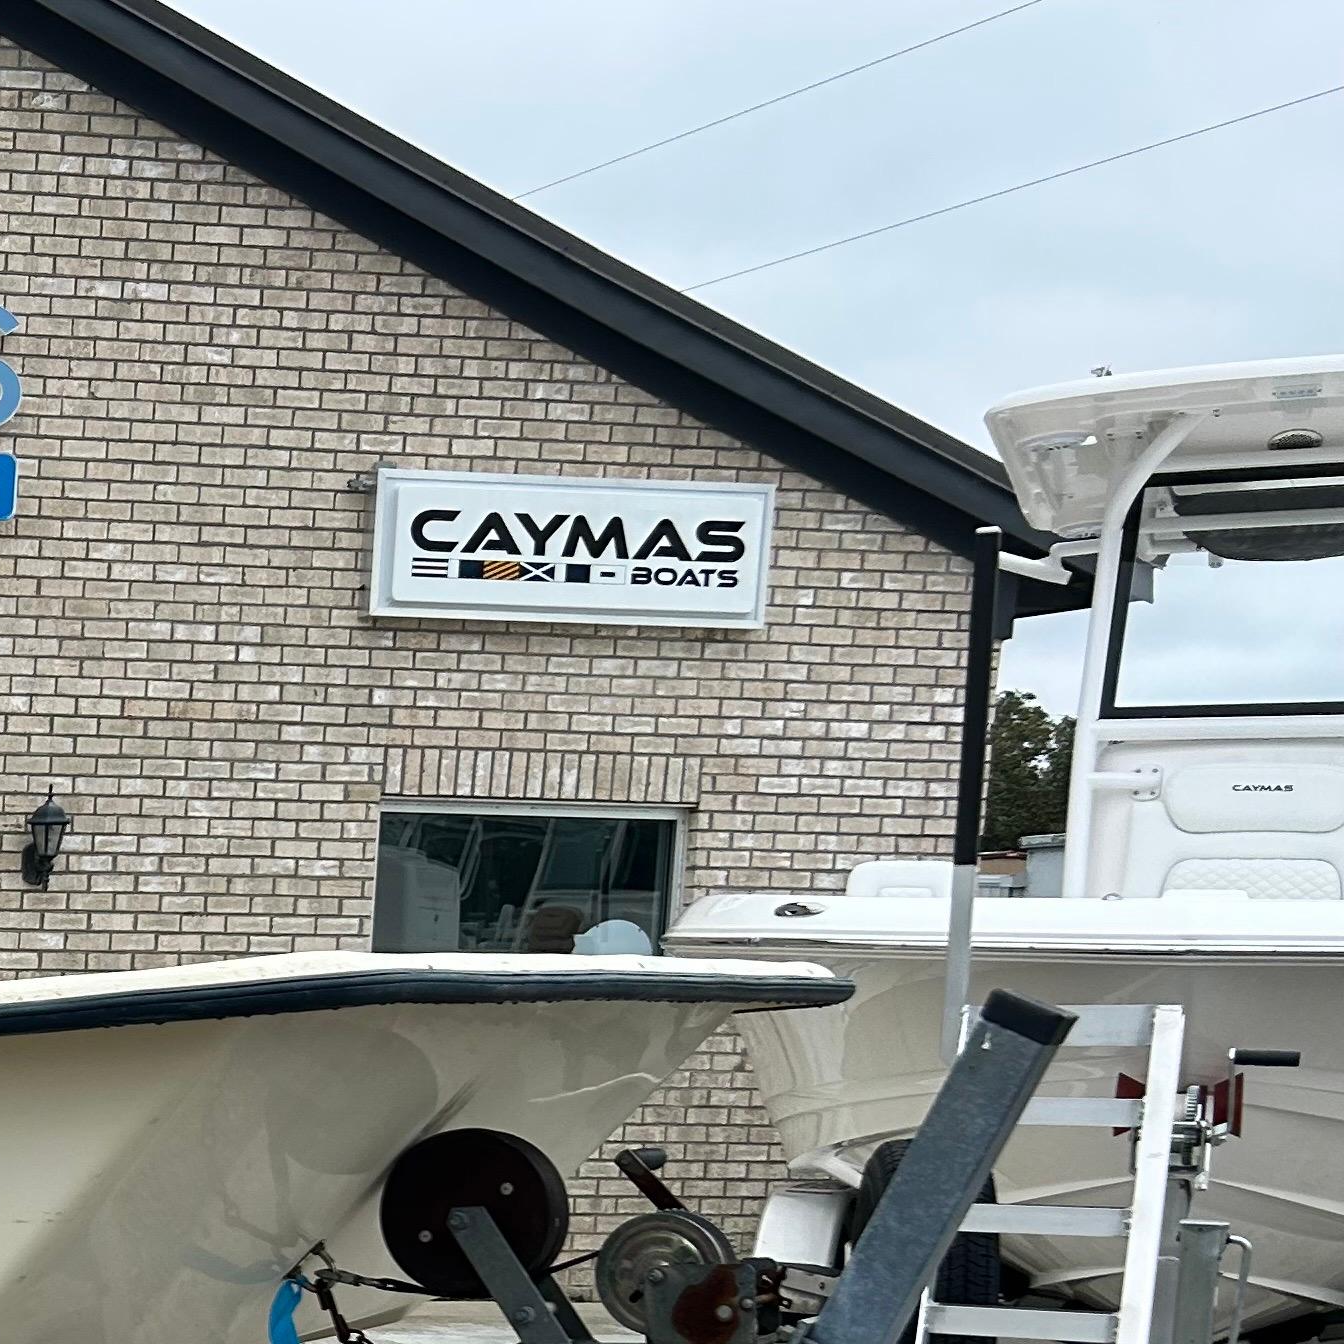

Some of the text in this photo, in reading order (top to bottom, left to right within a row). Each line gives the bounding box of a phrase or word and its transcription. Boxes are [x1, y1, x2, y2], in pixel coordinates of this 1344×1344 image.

[411, 508, 746, 563] CAYMAS
[630, 566, 739, 589] BOATS
[1231, 784, 1294, 792] CAYMAS
